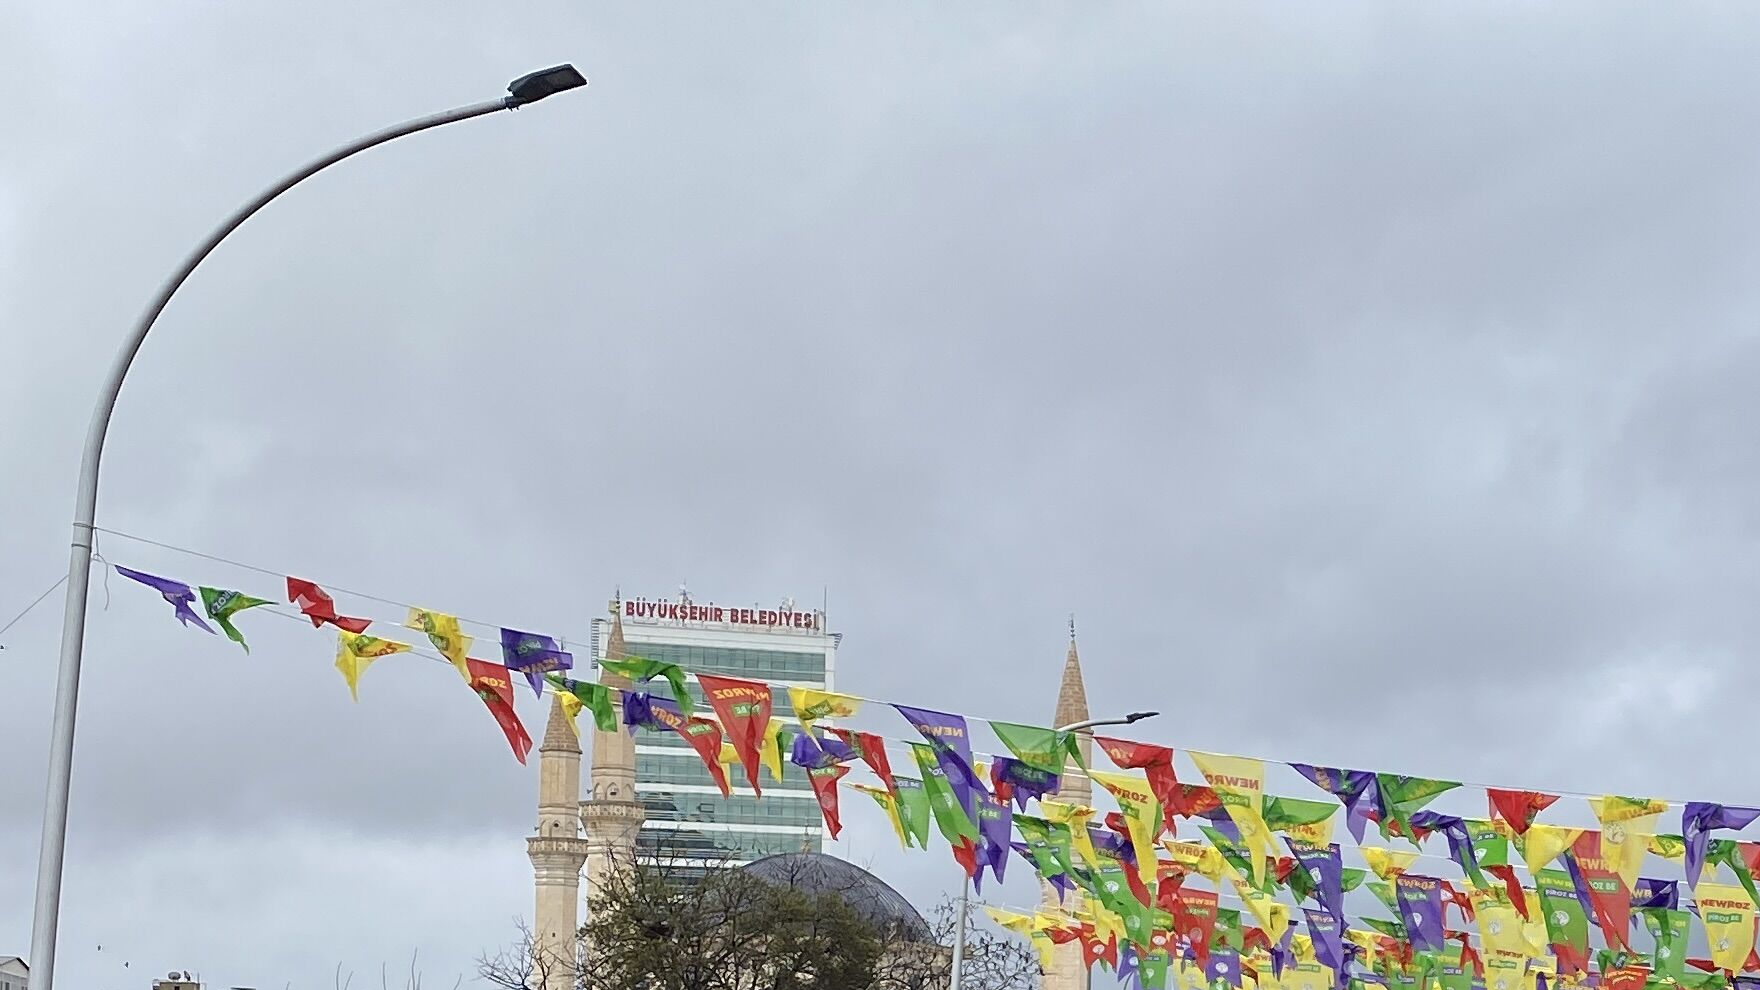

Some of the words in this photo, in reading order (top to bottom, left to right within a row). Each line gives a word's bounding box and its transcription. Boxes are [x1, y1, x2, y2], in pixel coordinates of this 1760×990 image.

[625, 597, 723, 624] BÜYÜKŞEHİR
[730, 603, 819, 629] BELEDİYESİ
[1701, 899, 1751, 911] NEWROZ
